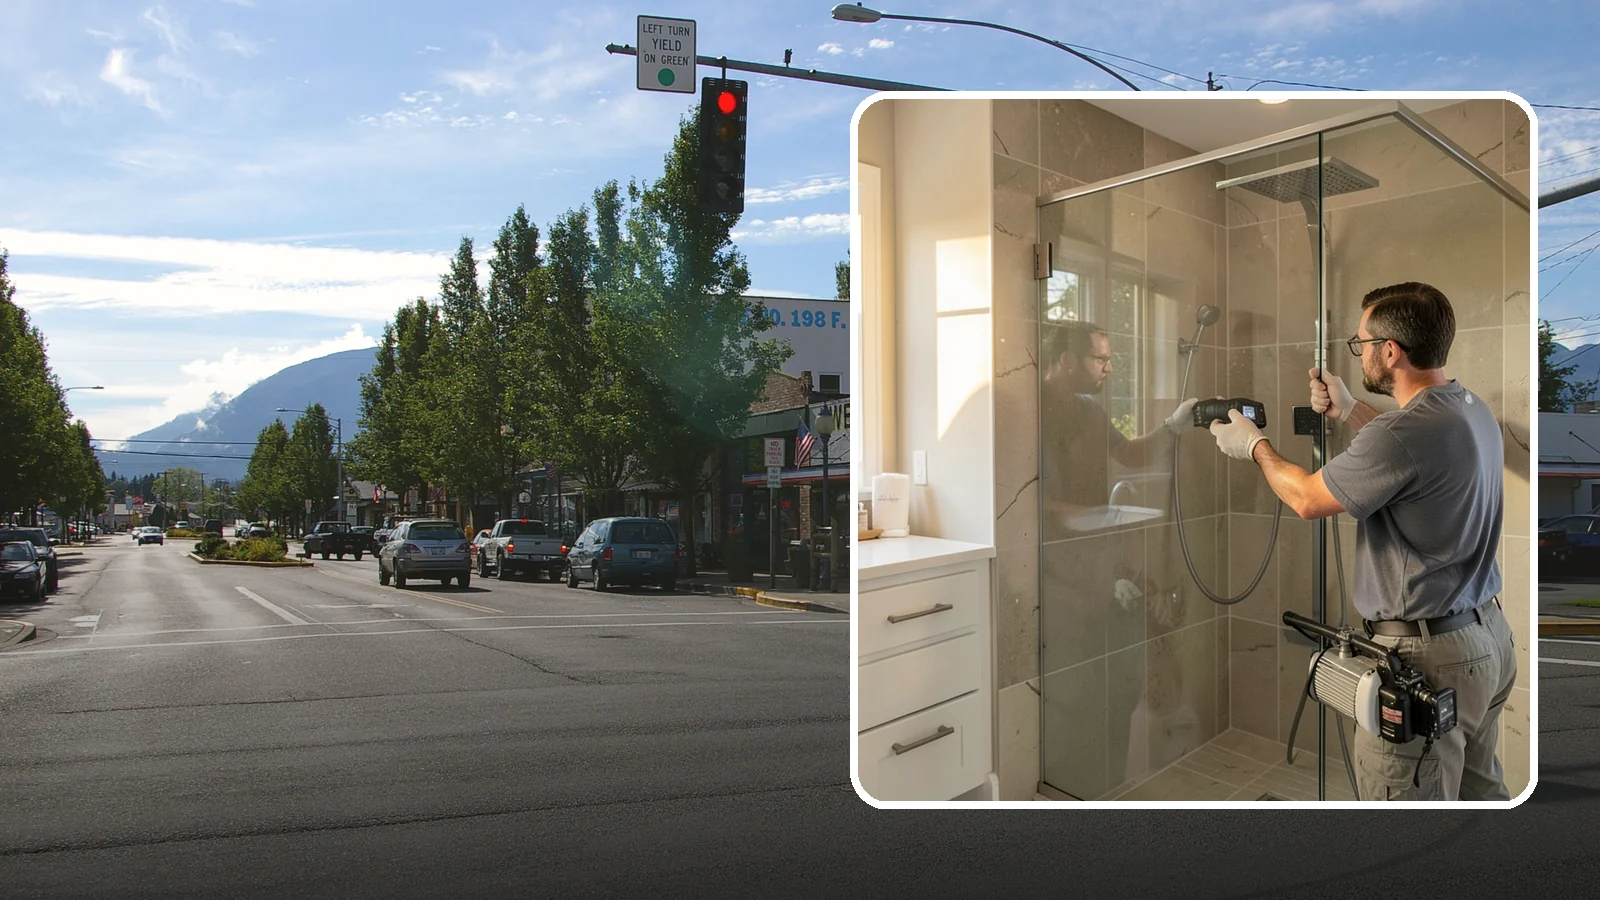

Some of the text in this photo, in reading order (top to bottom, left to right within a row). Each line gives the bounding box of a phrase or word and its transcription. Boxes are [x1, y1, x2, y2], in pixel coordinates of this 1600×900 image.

[643, 23, 690, 36] LEFT TURN
[652, 38, 682, 52] YIELD
[644, 53, 688, 66] ON GREEN
[791, 309, 826, 328] 198
[831, 311, 846, 329] F.
